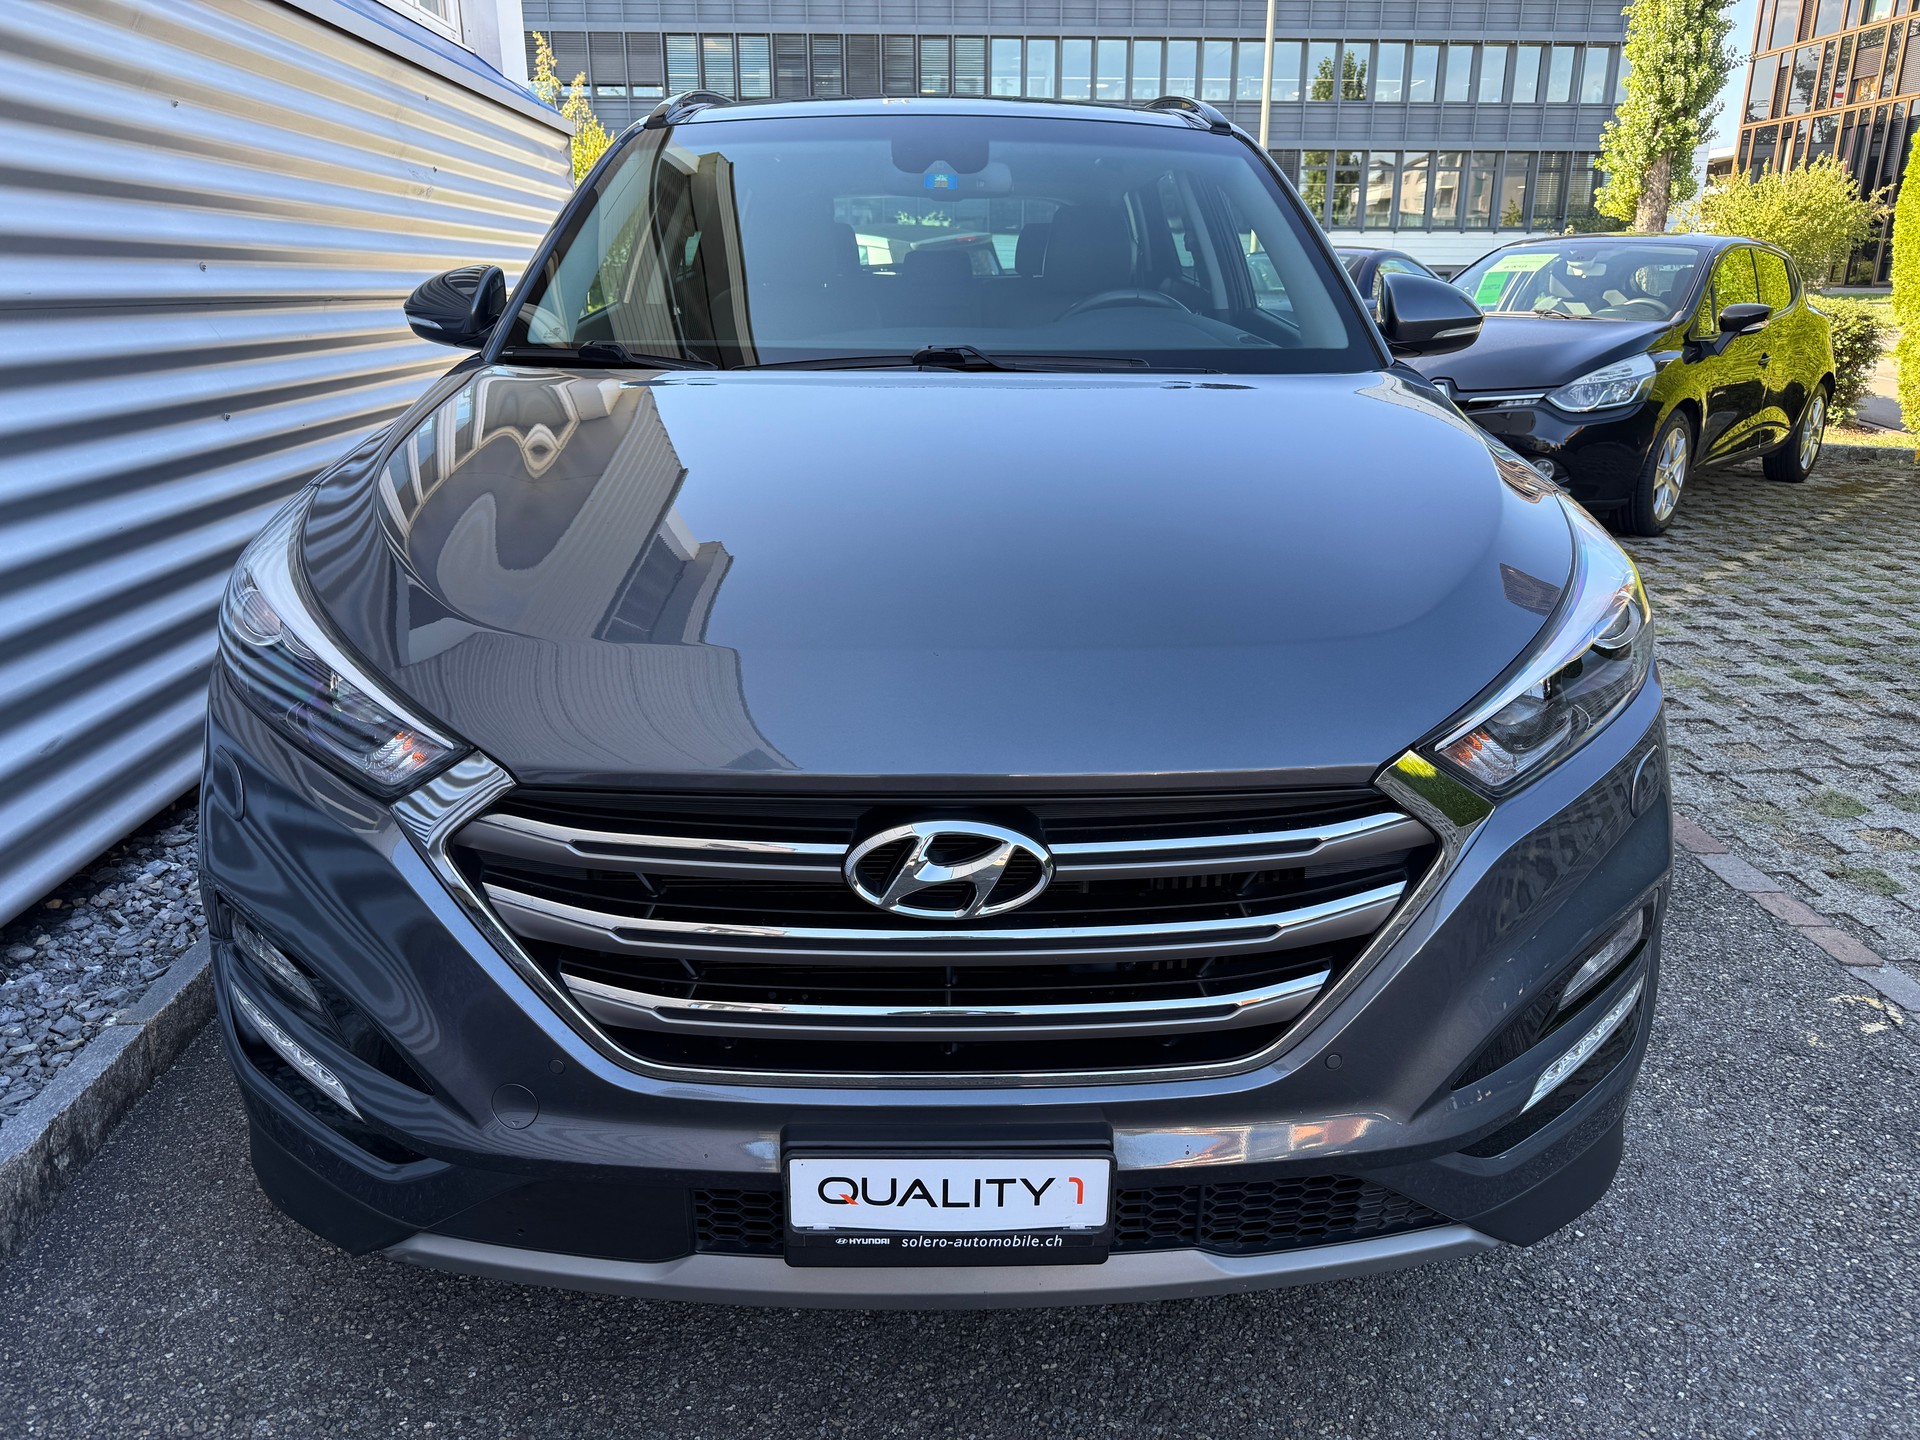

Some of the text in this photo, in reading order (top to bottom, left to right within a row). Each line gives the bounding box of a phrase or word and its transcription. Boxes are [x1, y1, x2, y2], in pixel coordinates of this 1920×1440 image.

[818, 1177, 1084, 1207] QUALITY 1
[901, 1235, 1063, 1247] solero-automobile.ch
